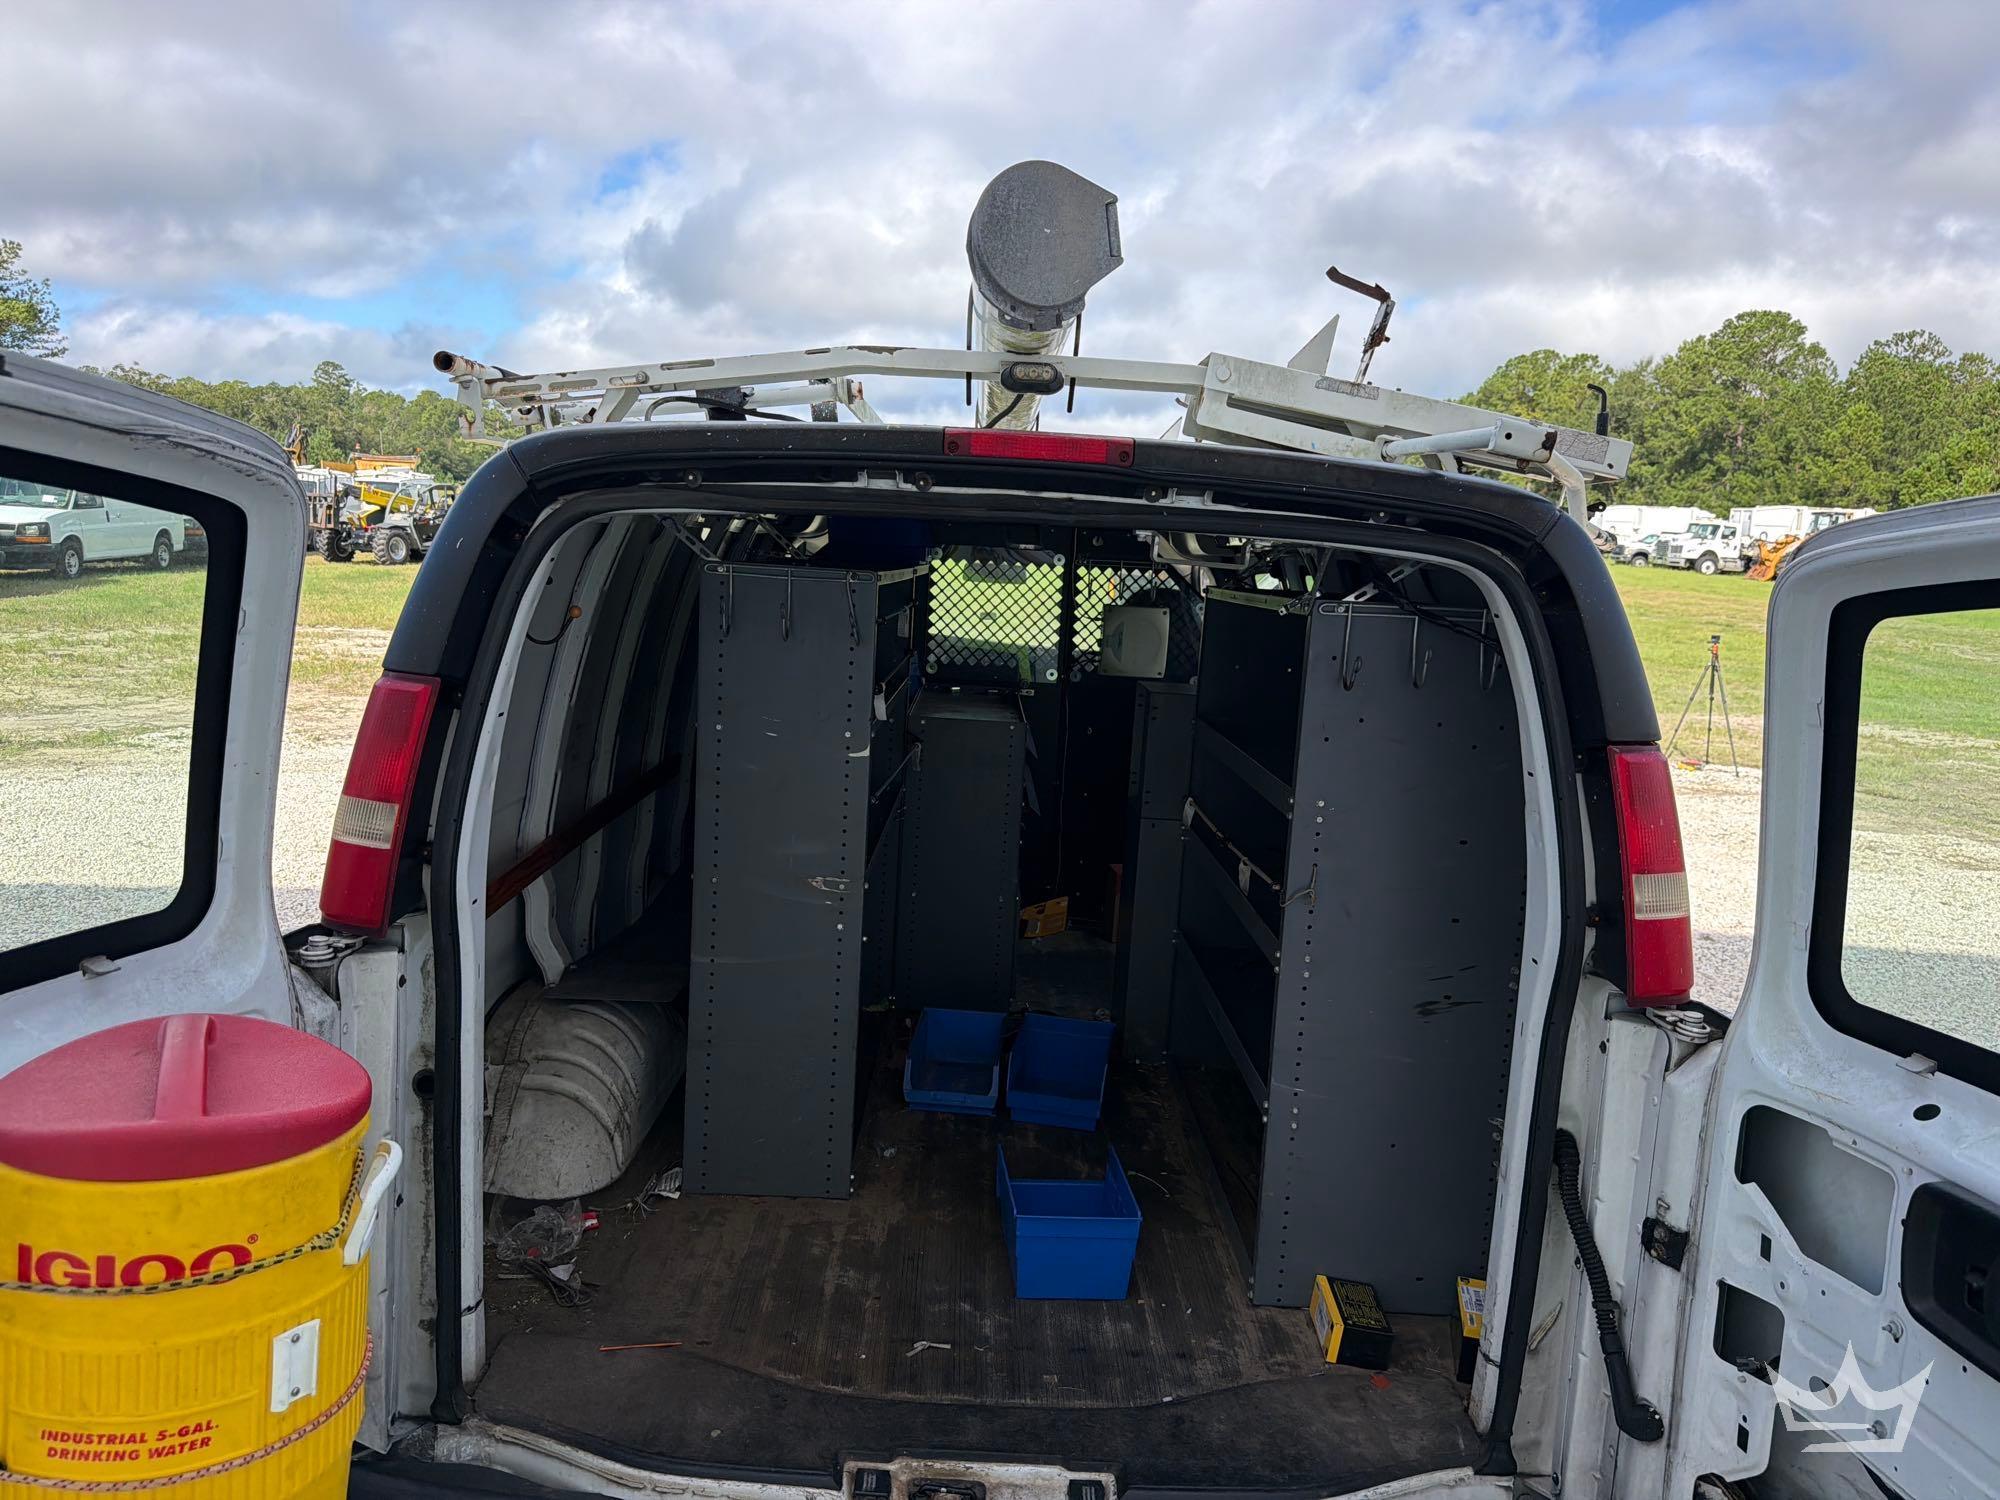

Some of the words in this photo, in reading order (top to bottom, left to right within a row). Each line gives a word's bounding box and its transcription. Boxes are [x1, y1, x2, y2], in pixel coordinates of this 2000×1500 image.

[40, 1429, 148, 1446] INDUSTRIAL
[156, 1419, 220, 1442] 5-GAL.
[47, 1446, 141, 1463] DRINKING
[148, 1436, 212, 1460] WATER
